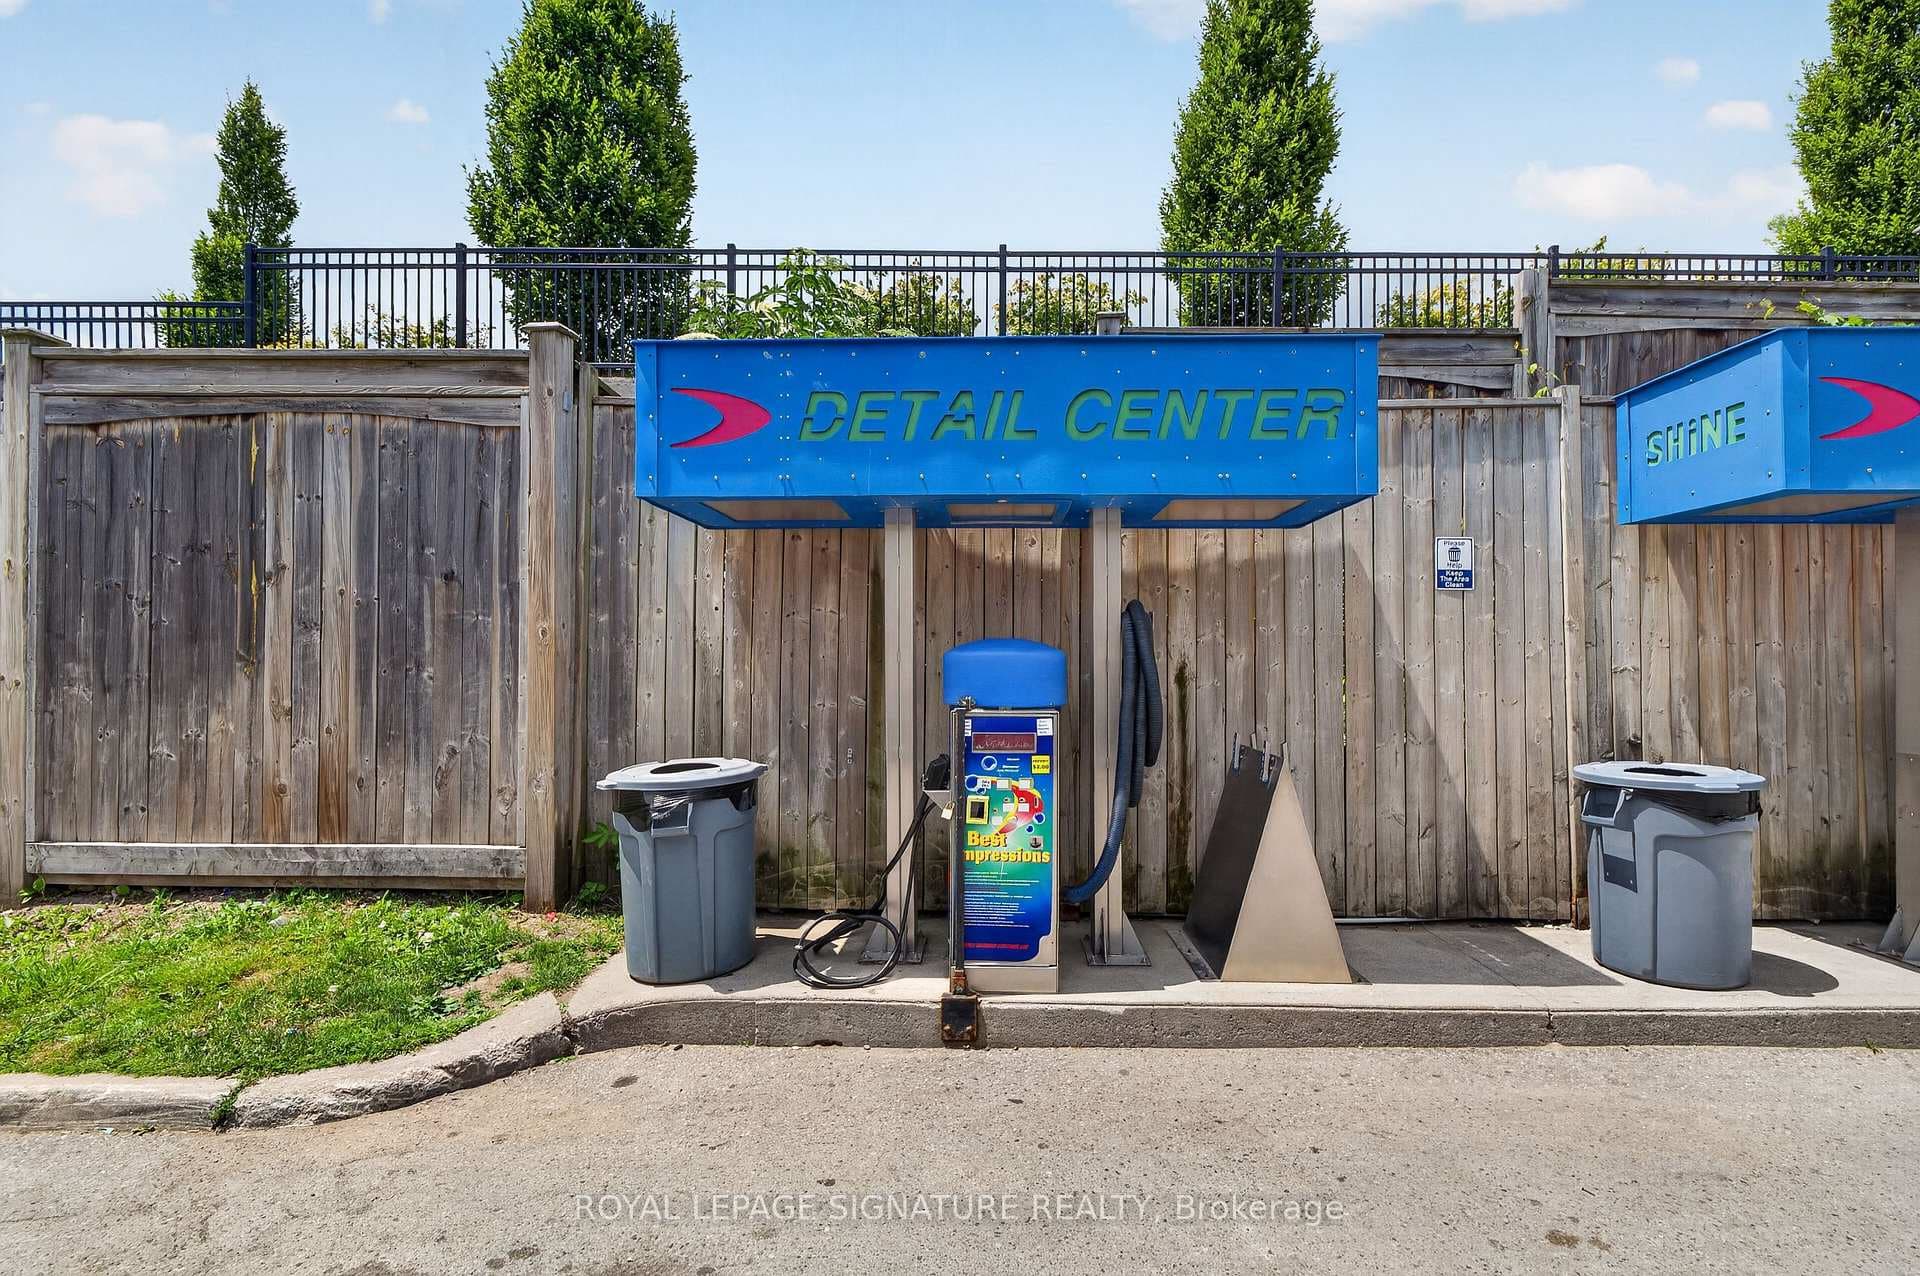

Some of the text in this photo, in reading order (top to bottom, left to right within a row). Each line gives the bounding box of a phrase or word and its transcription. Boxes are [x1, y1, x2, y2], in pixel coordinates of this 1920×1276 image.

[798, 388, 1346, 441] DETAIL CENTER
[967, 831, 1007, 847] Best
[963, 848, 1051, 865] mpressions
